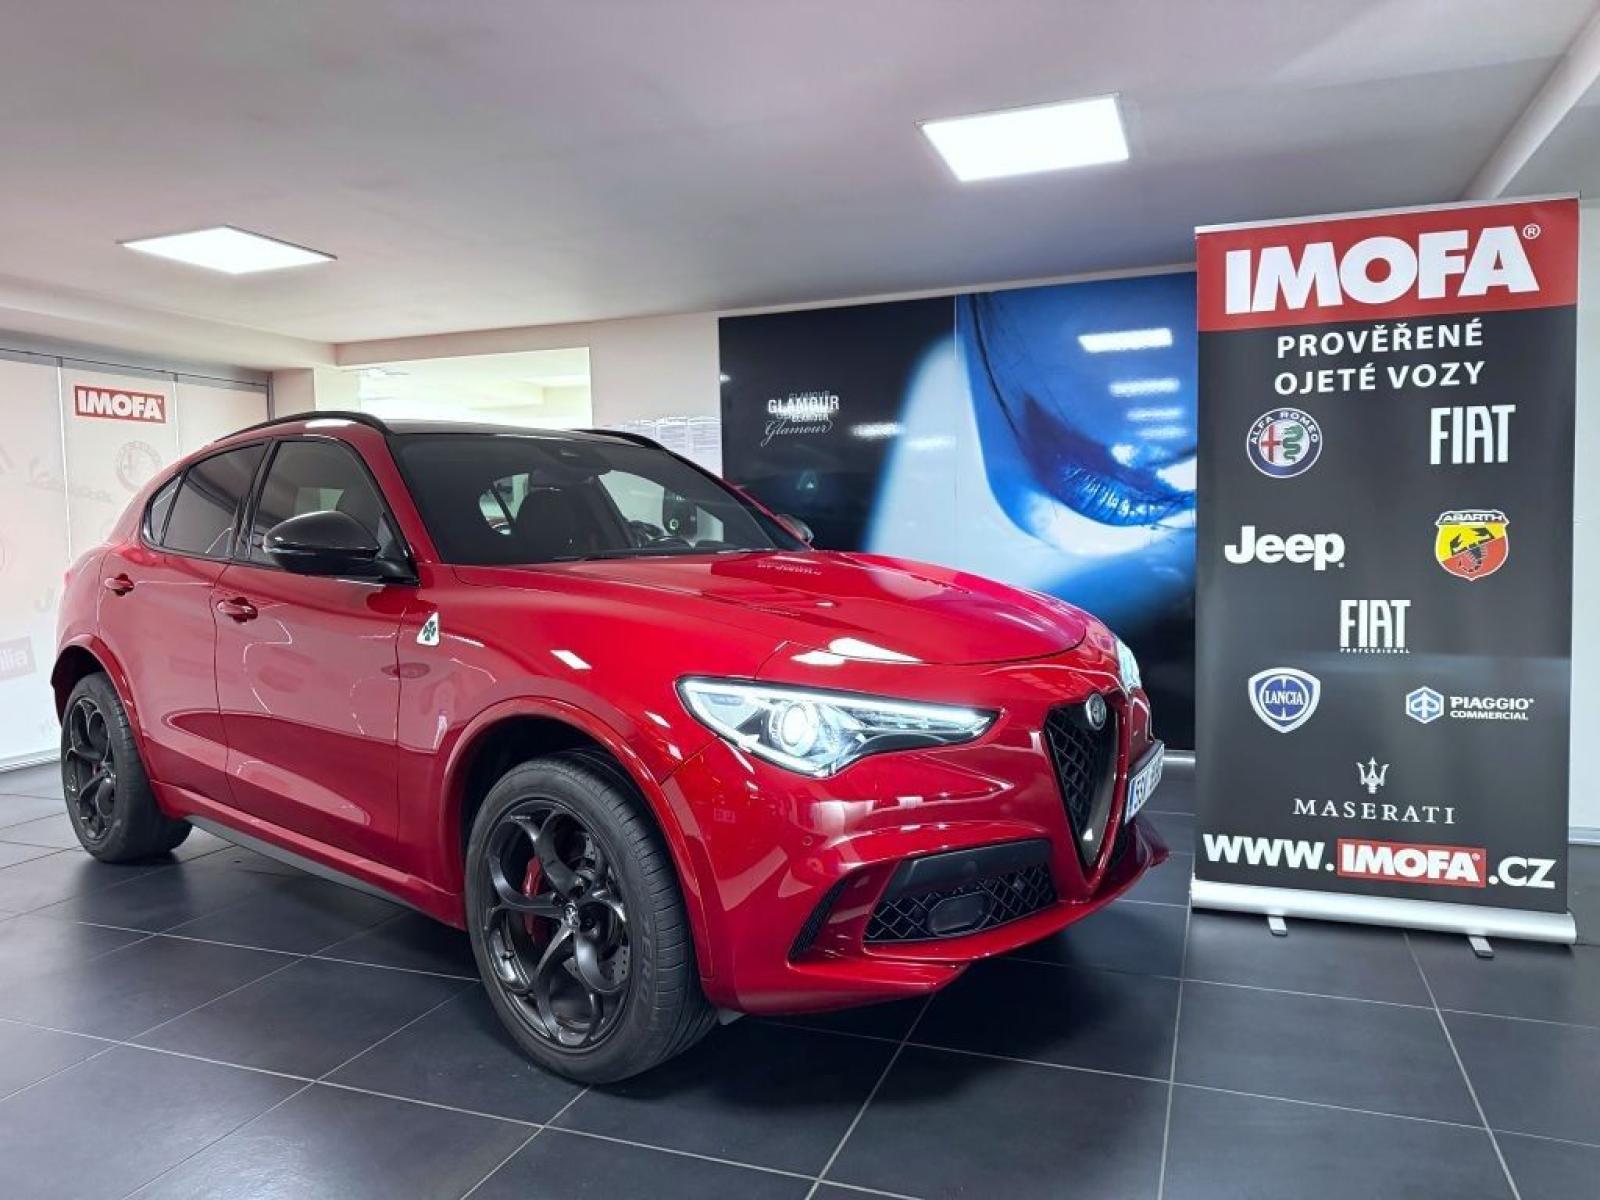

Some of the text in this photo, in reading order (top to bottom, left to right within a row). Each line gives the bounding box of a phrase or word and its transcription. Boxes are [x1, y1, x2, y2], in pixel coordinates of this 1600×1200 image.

[1277, 318, 1483, 359] PROVĚŘENÉ
[1274, 360, 1486, 396] OJETÉ VOZY
[767, 394, 840, 414] GLAMOUR
[760, 419, 834, 447] Glamour
[1430, 404, 1516, 465] FIAT
[1443, 513, 1503, 522] ABARTH
[1224, 525, 1345, 571] Jeep
[1340, 599, 1412, 648] FIAT
[1264, 689, 1304, 706] LANCIA
[1449, 710, 1529, 721] COMMERCIAL
[1292, 798, 1456, 825] MASERATI
